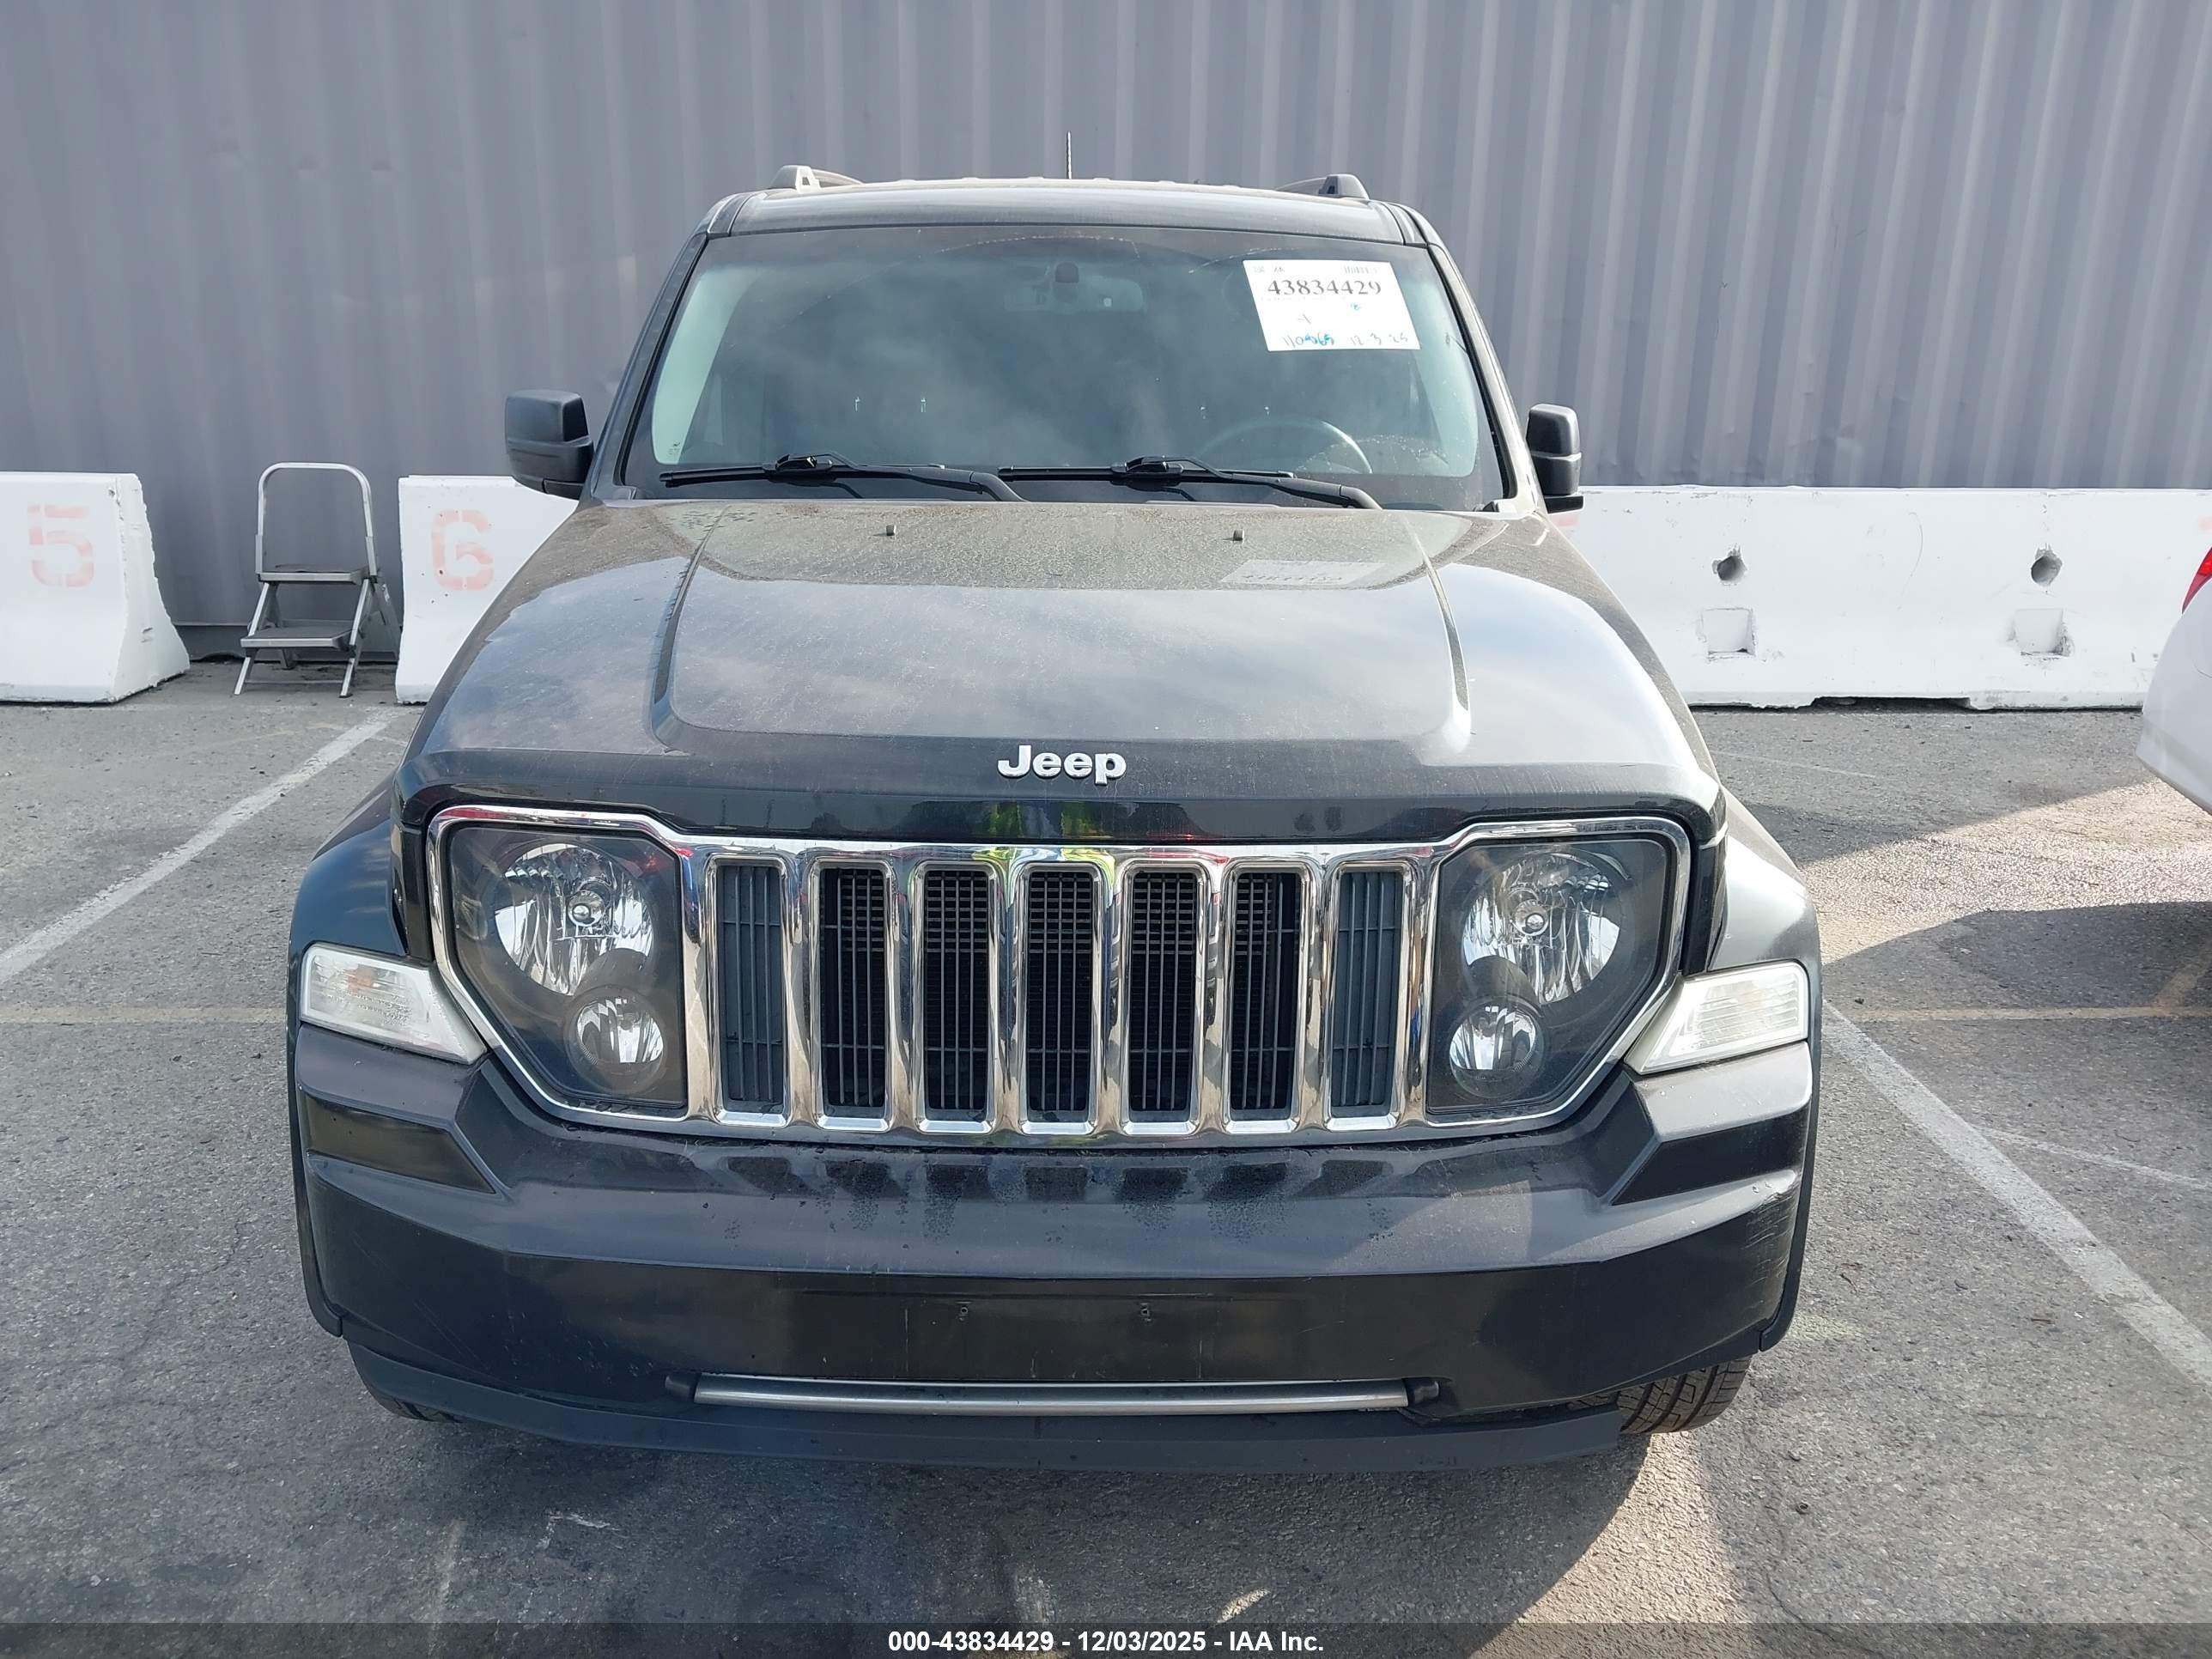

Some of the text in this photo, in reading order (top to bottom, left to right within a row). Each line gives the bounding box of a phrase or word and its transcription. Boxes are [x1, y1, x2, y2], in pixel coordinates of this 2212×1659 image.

[1267, 279, 1382, 295] 43834429
[27, 504, 94, 587] 5
[431, 508, 495, 591] 6
[997, 744, 1127, 785] Jeep
